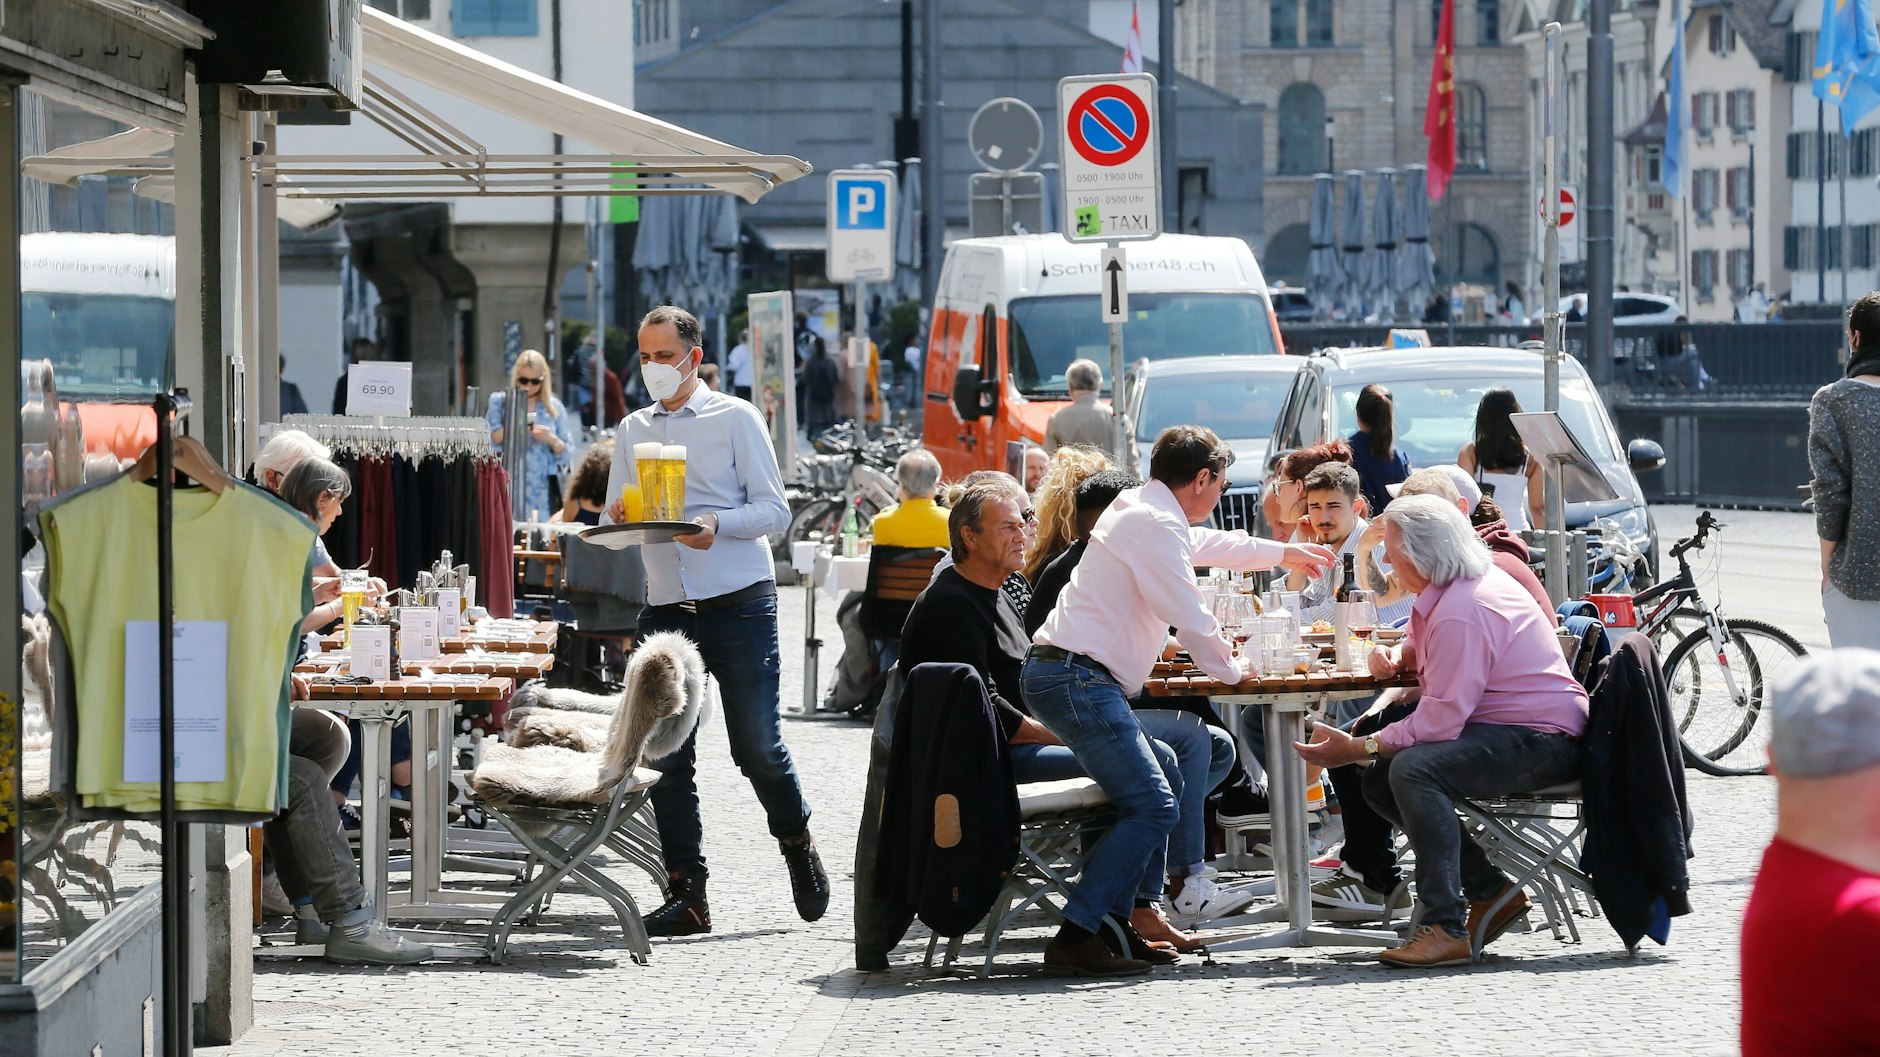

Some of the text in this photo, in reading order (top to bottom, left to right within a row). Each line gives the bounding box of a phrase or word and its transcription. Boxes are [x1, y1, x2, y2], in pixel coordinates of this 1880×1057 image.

[1077, 174, 1098, 182] 0500
[1104, 173, 1126, 181] 1900
[1128, 172, 1143, 180] Uhr
[848, 186, 876, 225] P
[1078, 196, 1099, 205] 1900
[1105, 195, 1127, 204] 0500
[1129, 195, 1144, 203] Uhr
[1109, 214, 1148, 230] TAXI
[1051, 259, 1216, 277] Schrner48.ch
[363, 385, 395, 395] 69.90
